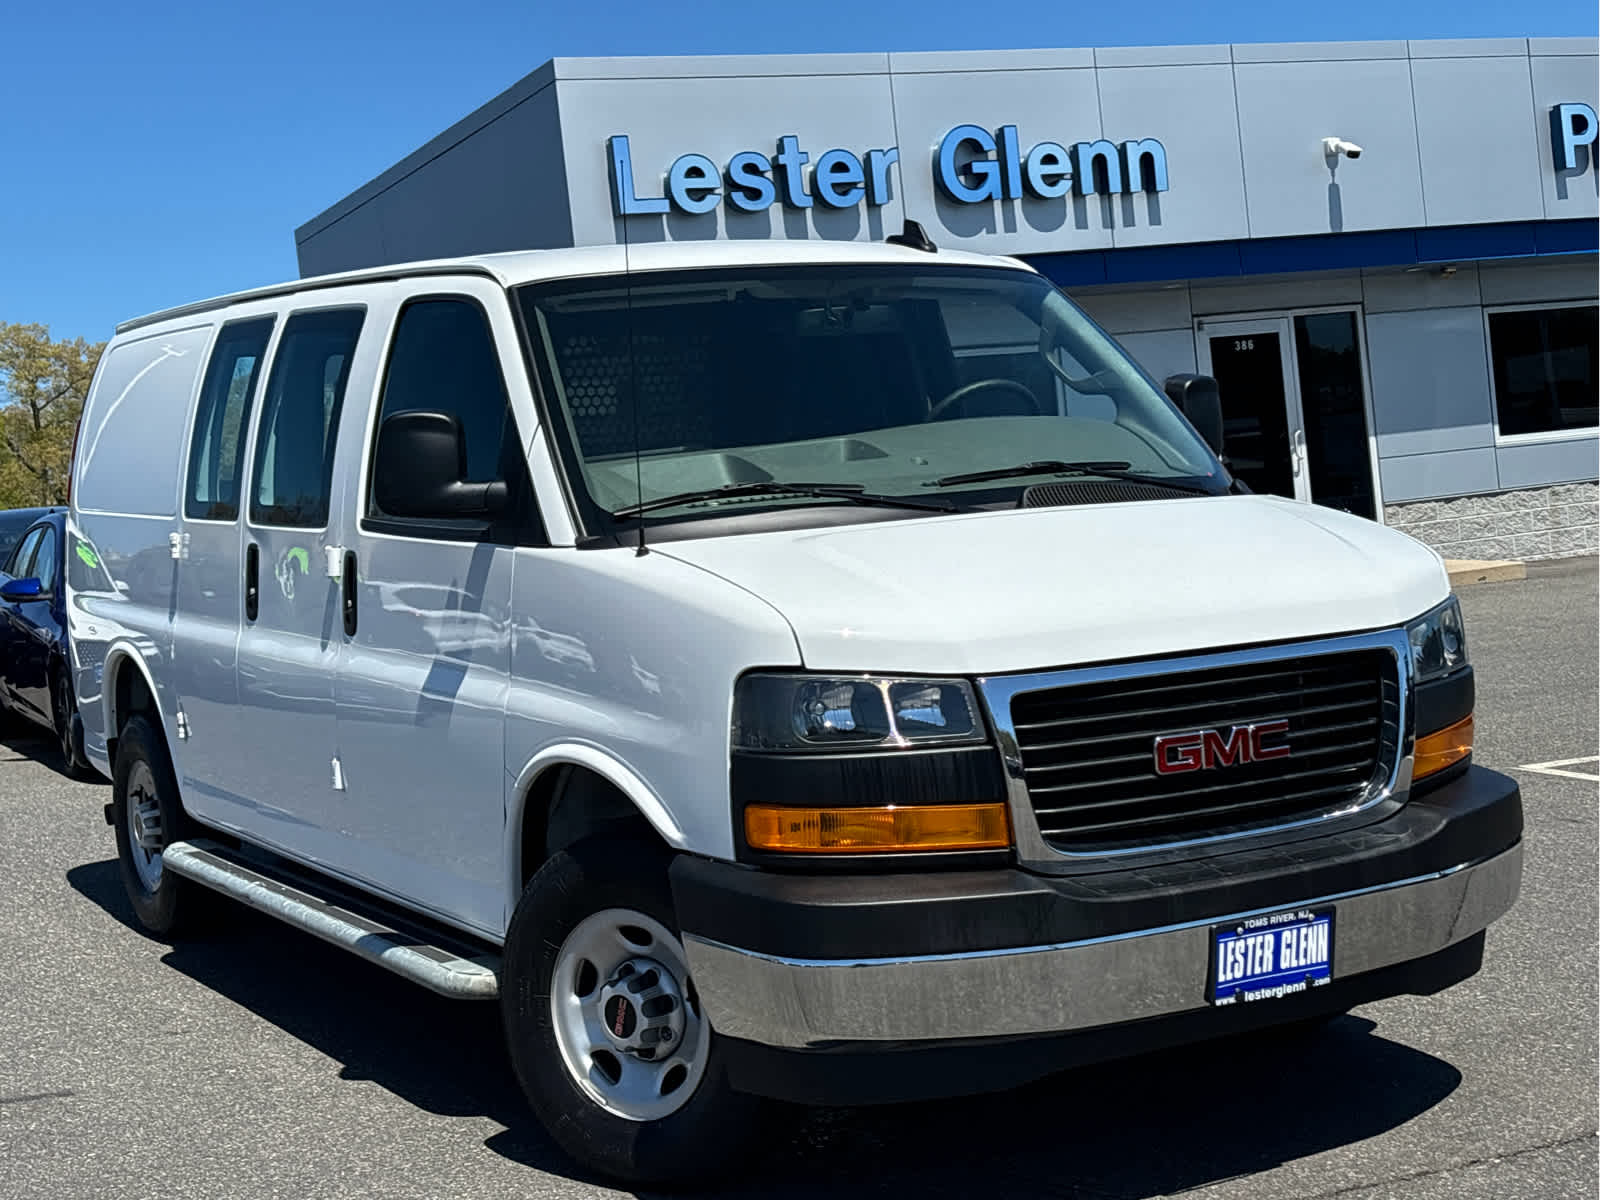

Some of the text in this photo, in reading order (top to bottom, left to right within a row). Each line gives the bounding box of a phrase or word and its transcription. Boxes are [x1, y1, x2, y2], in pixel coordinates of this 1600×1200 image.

[606, 124, 1168, 216] Lester Glenn
[1234, 339, 1254, 351] 386
[1154, 719, 1291, 775] GMC
[1244, 917, 1268, 929] TOMS
[1218, 923, 1328, 982] LESTER GLENN
[1244, 981, 1306, 1002] lesterglenn
